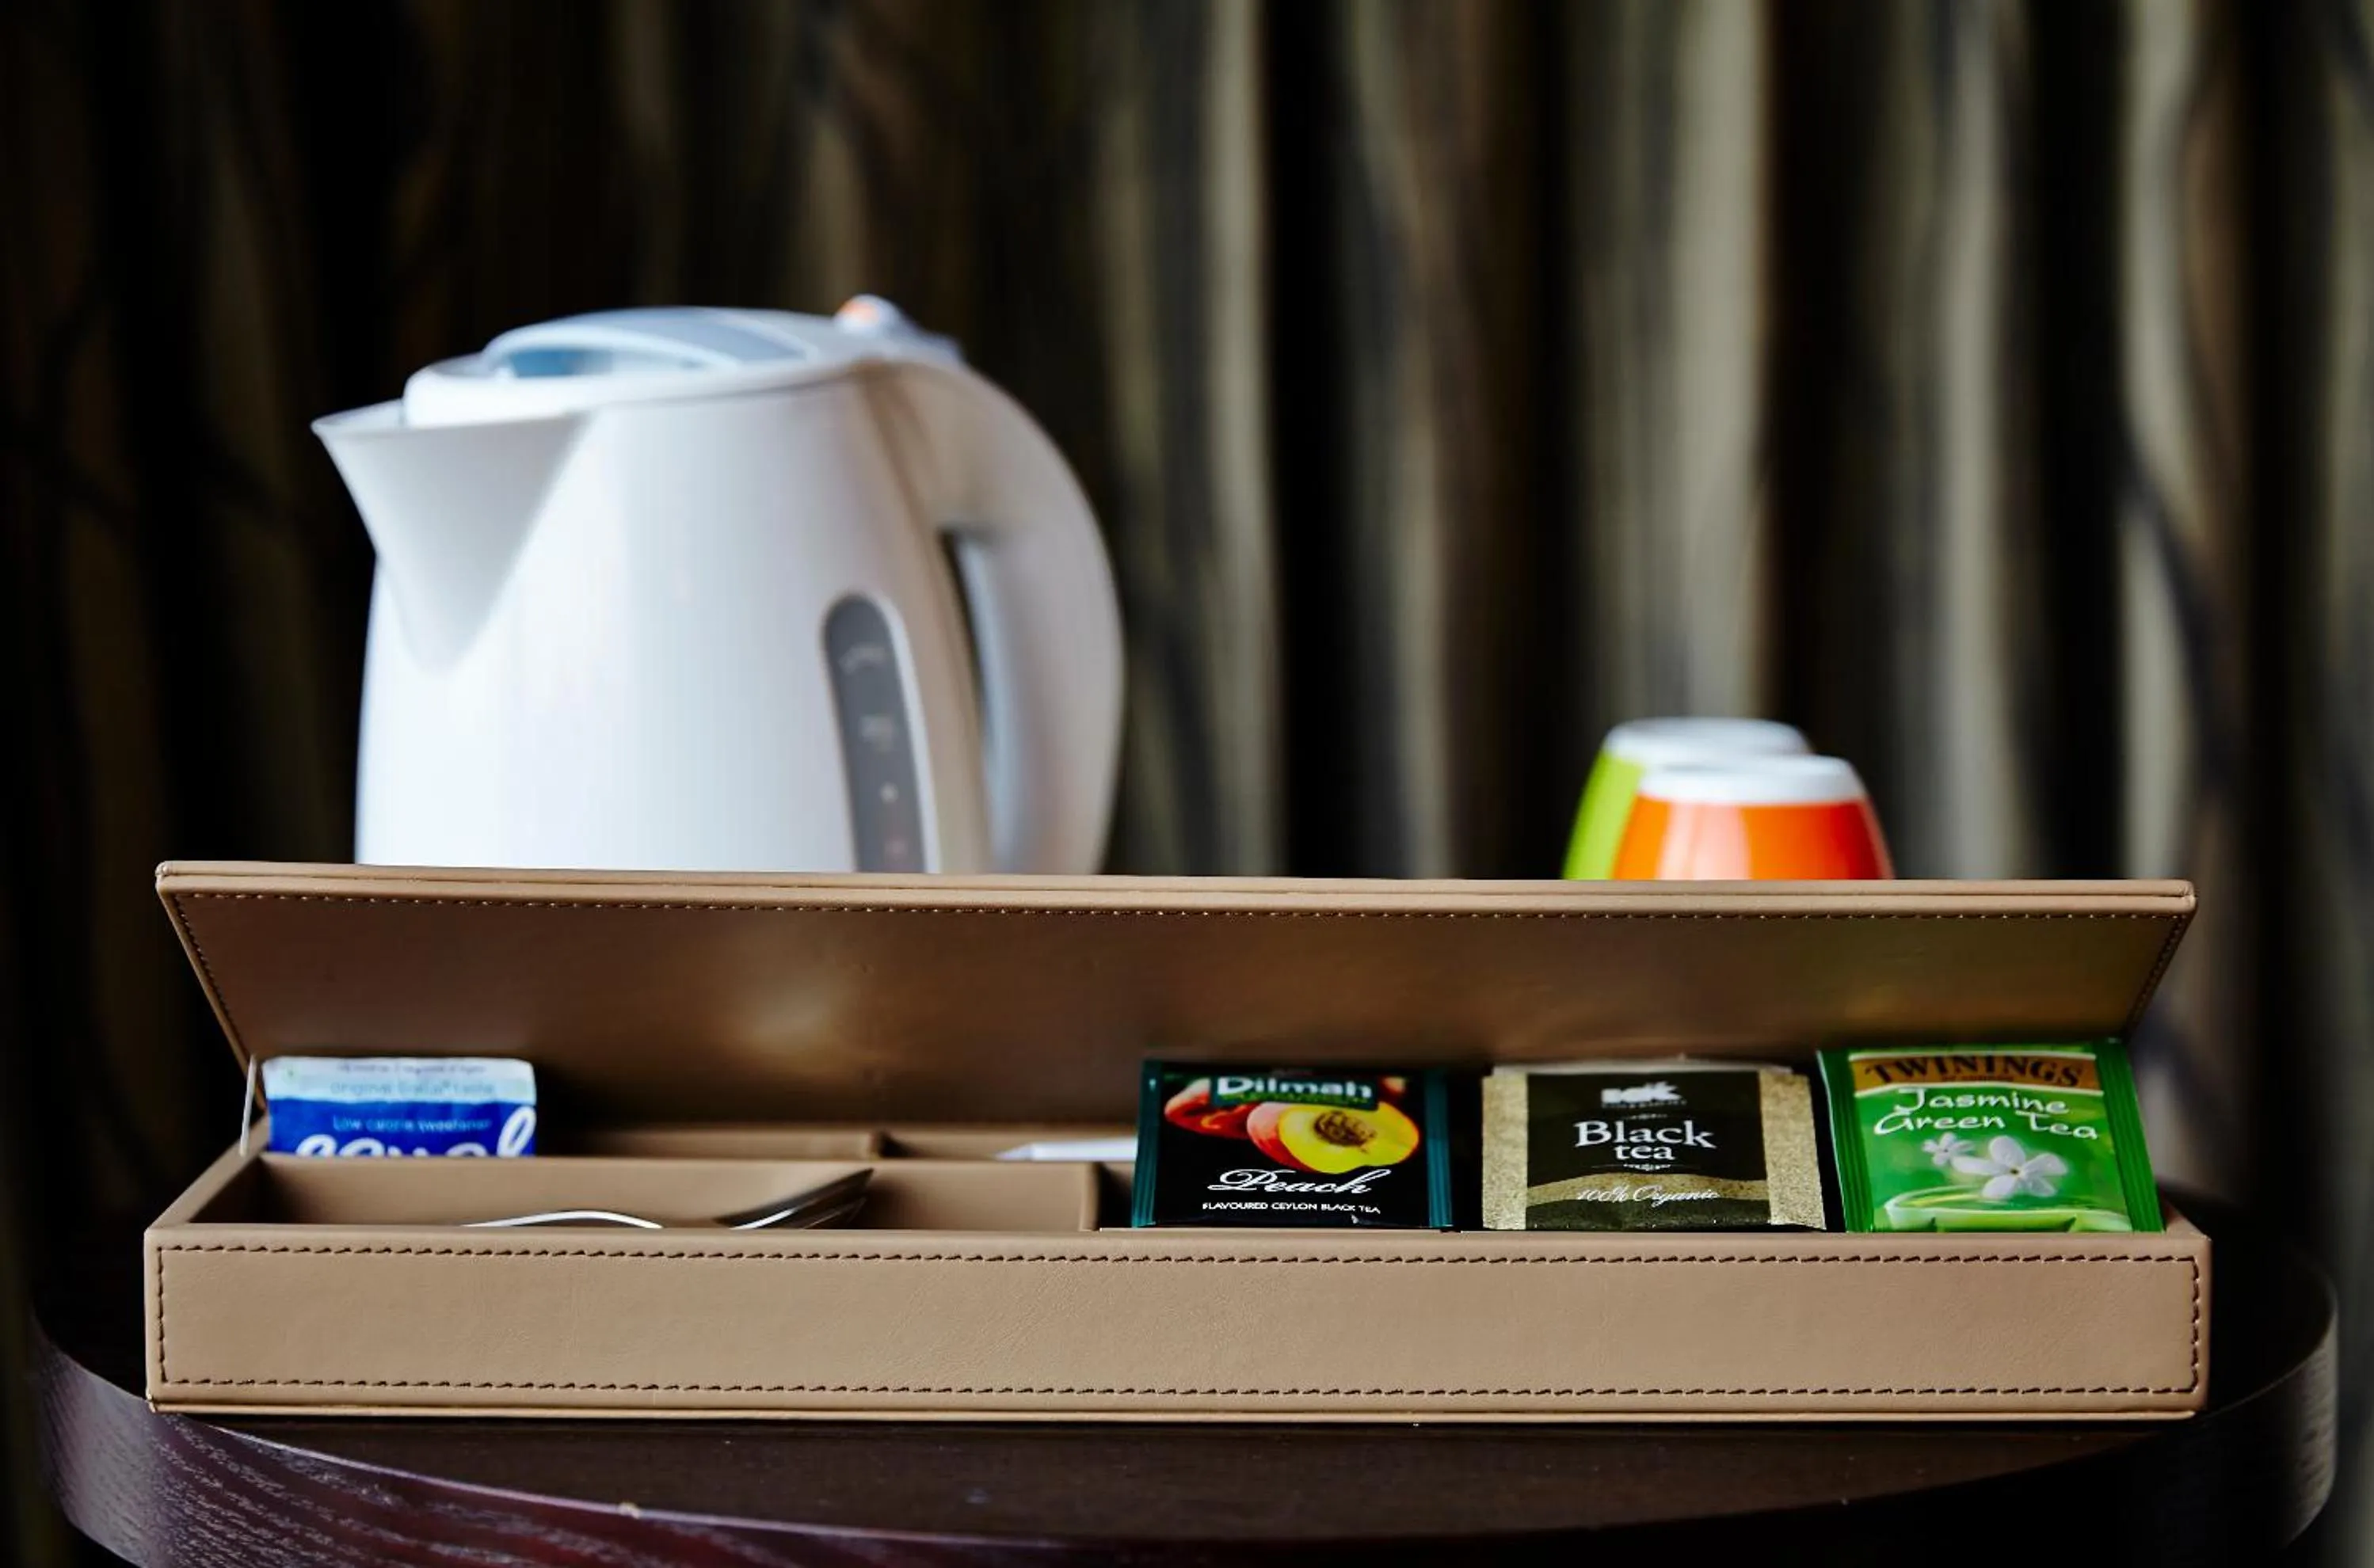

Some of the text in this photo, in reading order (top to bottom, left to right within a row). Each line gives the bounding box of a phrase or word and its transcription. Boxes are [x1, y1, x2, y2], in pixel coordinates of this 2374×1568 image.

[1865, 1054, 2082, 1087] TWININGS
[1217, 1075, 1373, 1098] Dilmah
[1893, 1087, 2070, 1114] Jasmine
[1572, 1120, 1717, 1149] Black
[1873, 1109, 2098, 1140] Green Tea
[1614, 1144, 1676, 1161] tea
[1207, 1168, 1392, 1194] Peach
[1202, 1201, 1381, 1214] FLAVOURED CEYLON BLACK TEA
[1576, 1184, 1720, 1208] 100% Organic
